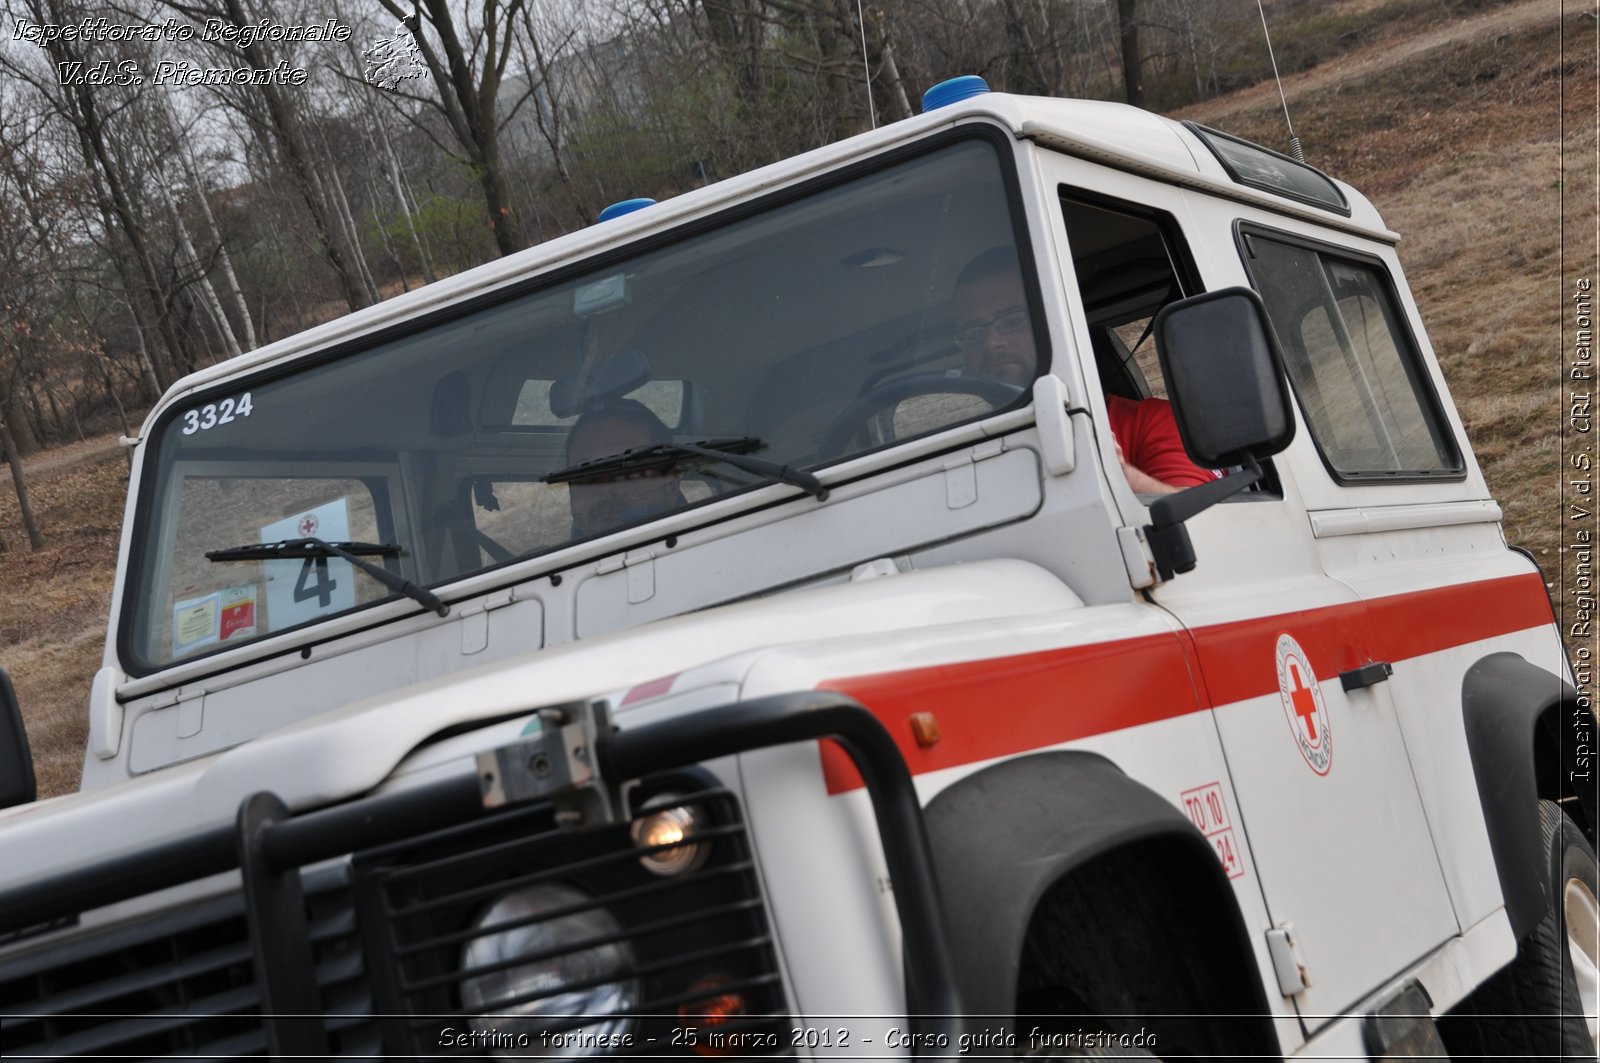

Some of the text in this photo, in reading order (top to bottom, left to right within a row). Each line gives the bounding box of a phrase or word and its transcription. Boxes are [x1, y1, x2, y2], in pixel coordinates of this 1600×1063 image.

[182, 391, 254, 436] 3324
[293, 553, 337, 608] 4
[1185, 790, 1223, 831] TO 10
